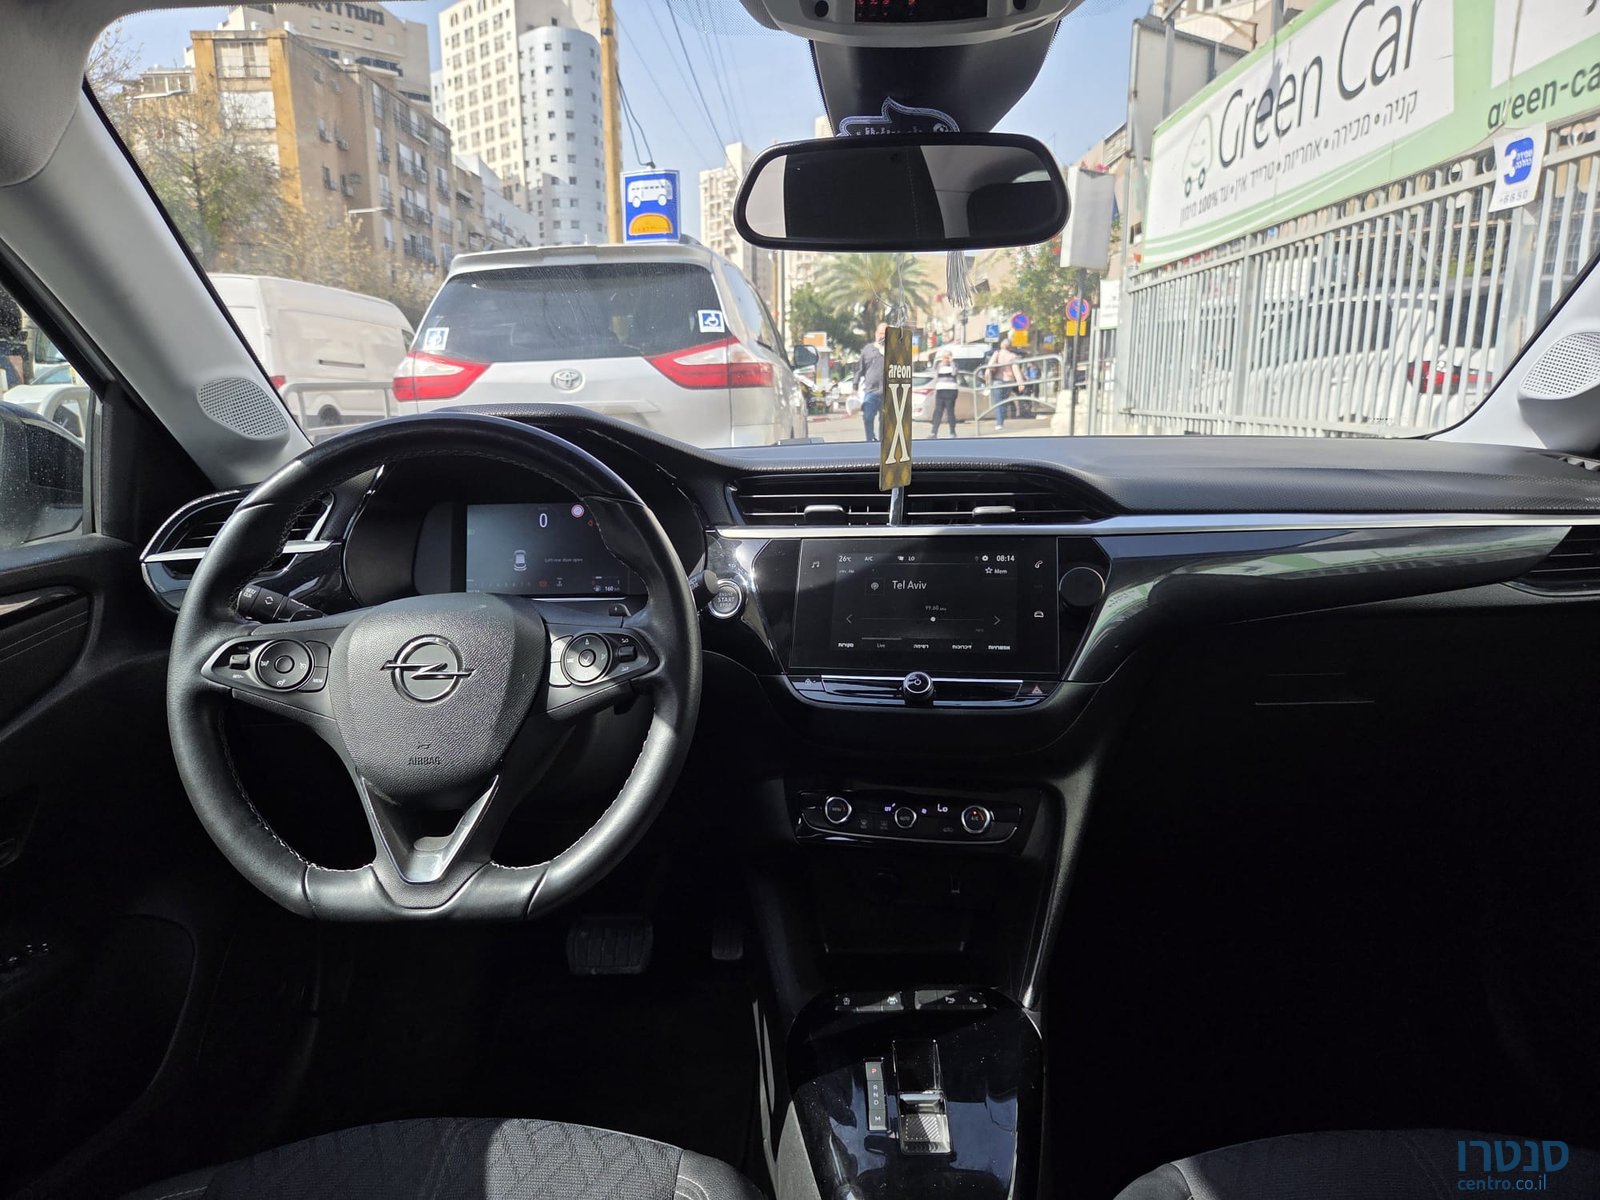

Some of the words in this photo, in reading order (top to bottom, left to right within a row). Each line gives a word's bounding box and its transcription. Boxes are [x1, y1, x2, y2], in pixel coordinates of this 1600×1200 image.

[1219, 56, 1323, 168] Green
[1337, 0, 1423, 100] Car
[1383, 90, 1418, 125] קניה
[1331, 113, 1370, 150] מכירה
[1282, 138, 1321, 173] אחריות
[1198, 192, 1218, 215] 100%
[888, 364, 911, 379] areon
[885, 383, 911, 464] X
[538, 513, 548, 528] 0
[892, 580, 905, 590] Tel
[907, 580, 927, 590] Aviv
[408, 756, 440, 766] AIRBAG
[937, 803, 949, 812] Lo
